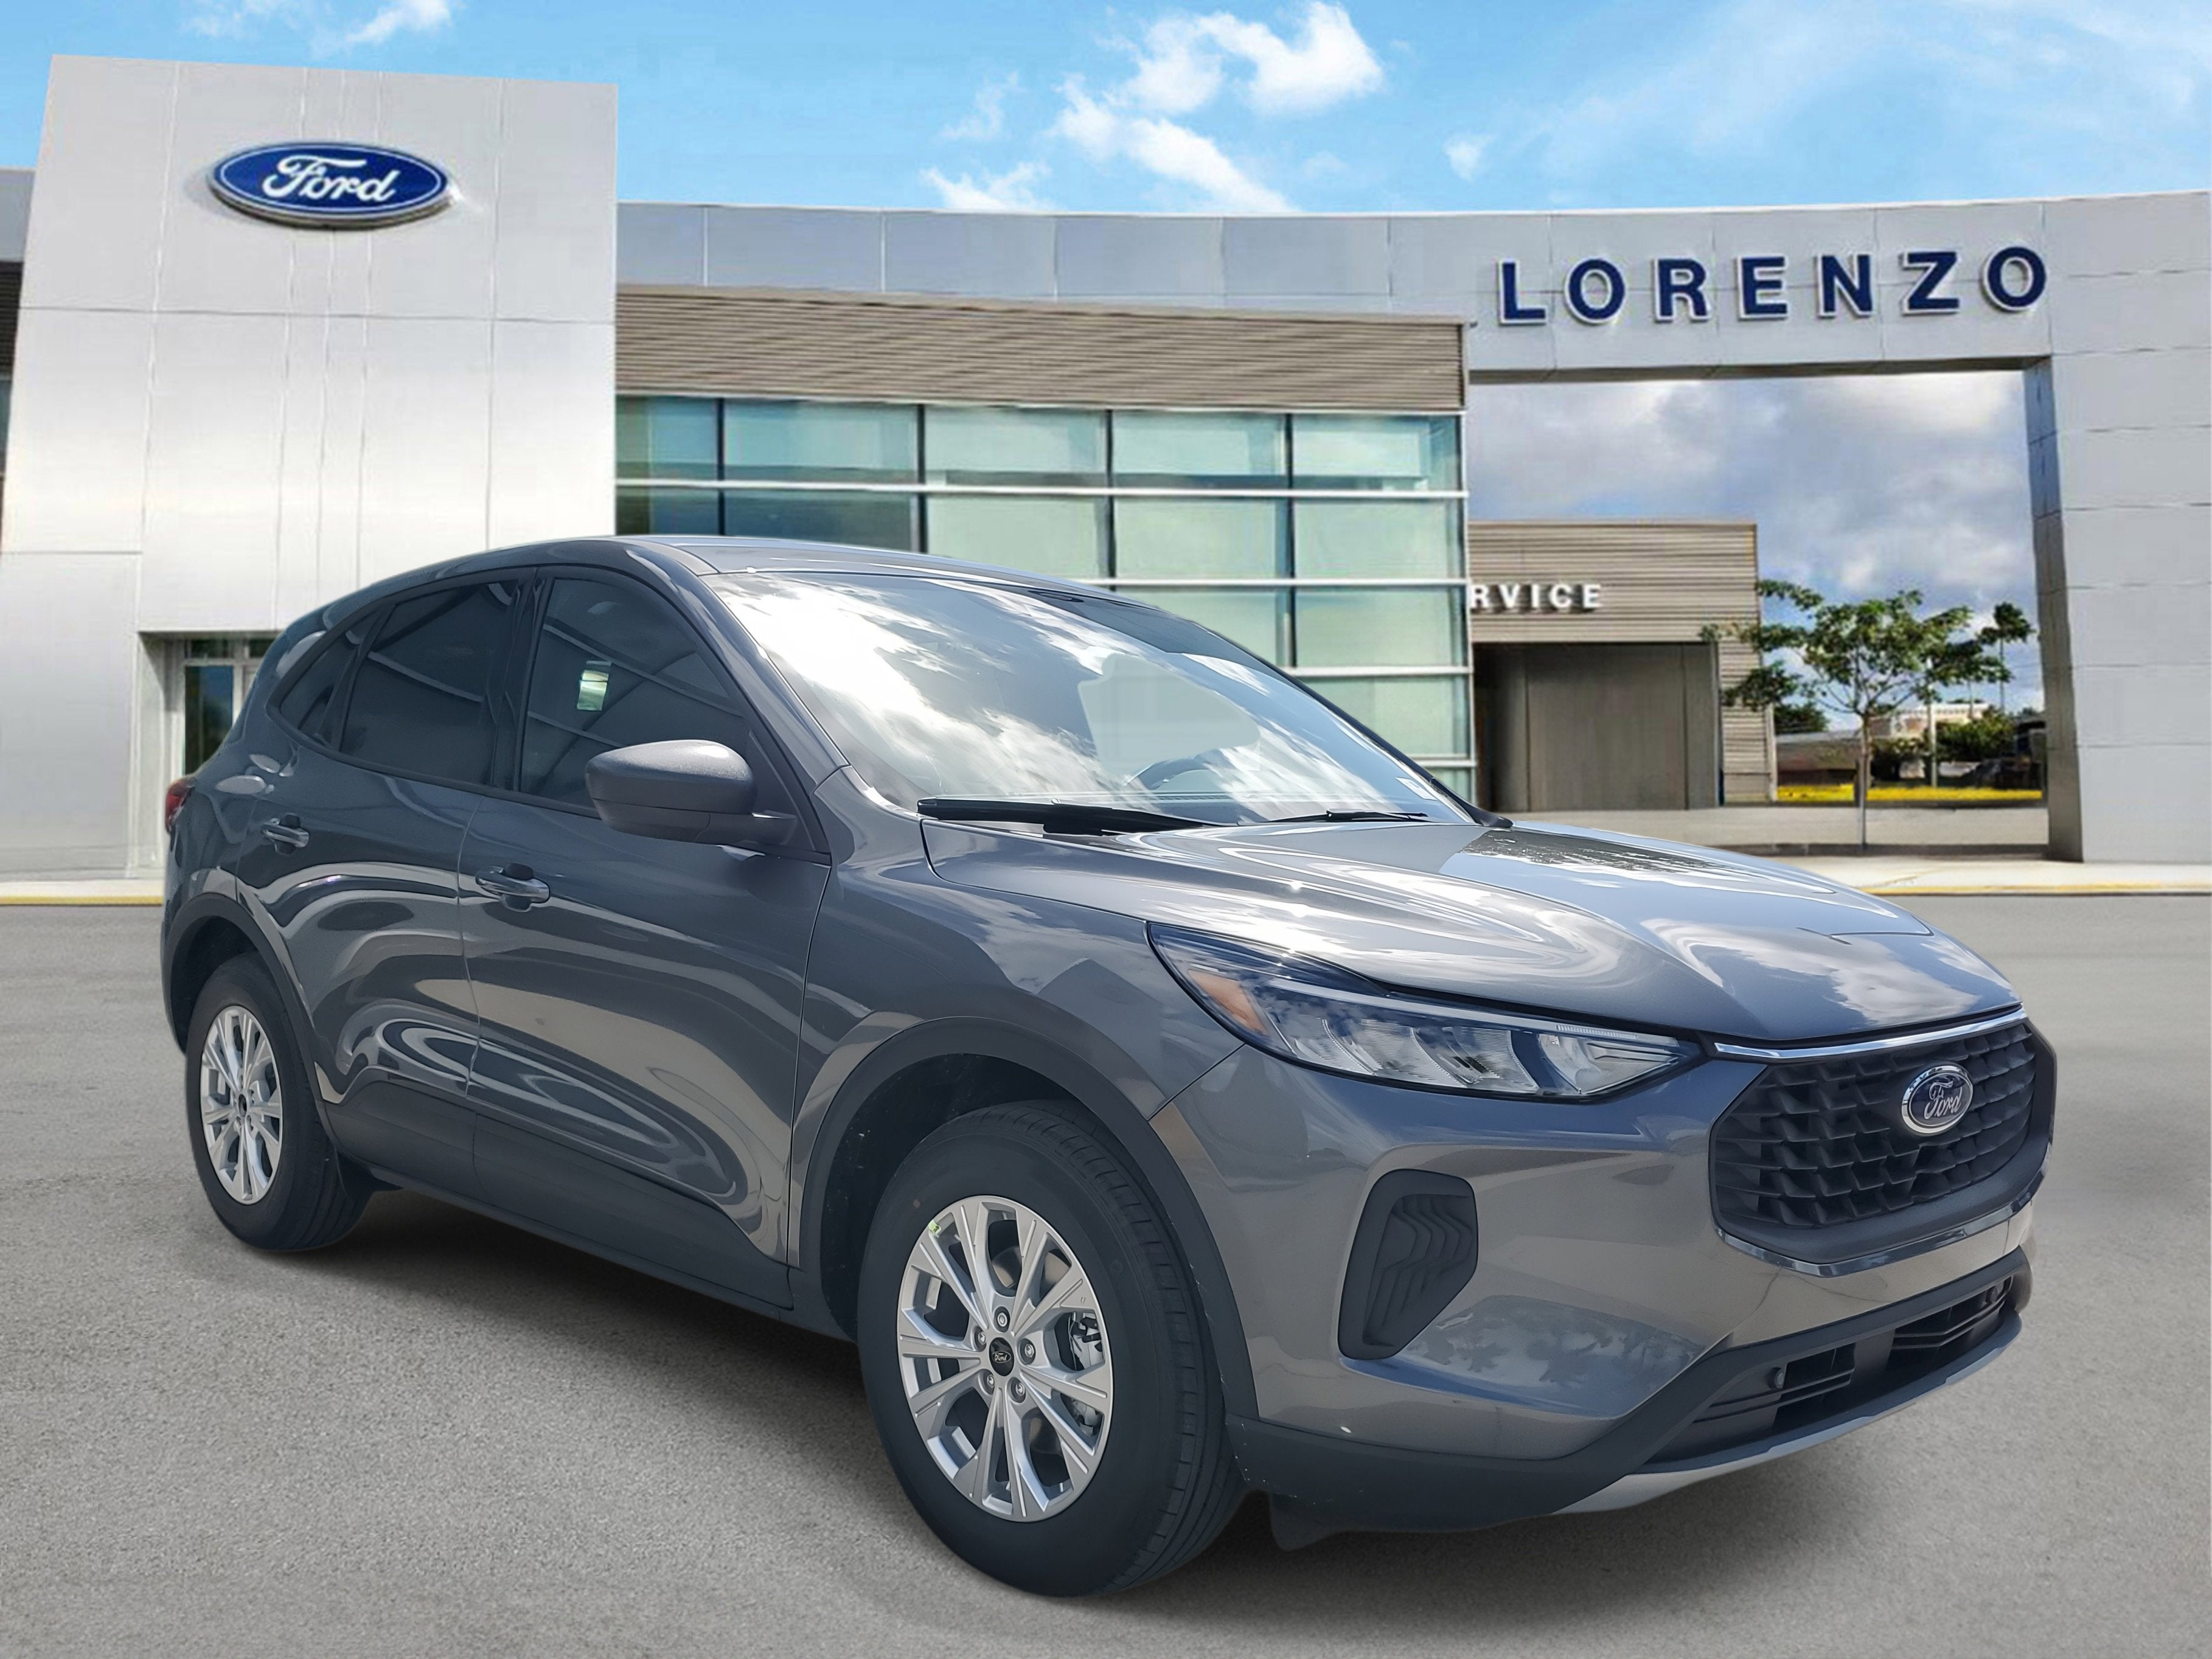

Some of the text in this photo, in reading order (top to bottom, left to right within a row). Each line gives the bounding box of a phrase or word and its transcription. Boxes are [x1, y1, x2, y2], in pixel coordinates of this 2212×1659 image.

[263, 155, 400, 201] Ford
[1498, 246, 2048, 325] LORENZO
[1924, 1082, 1962, 1119] Ford
[994, 1352, 1007, 1362] Ford
